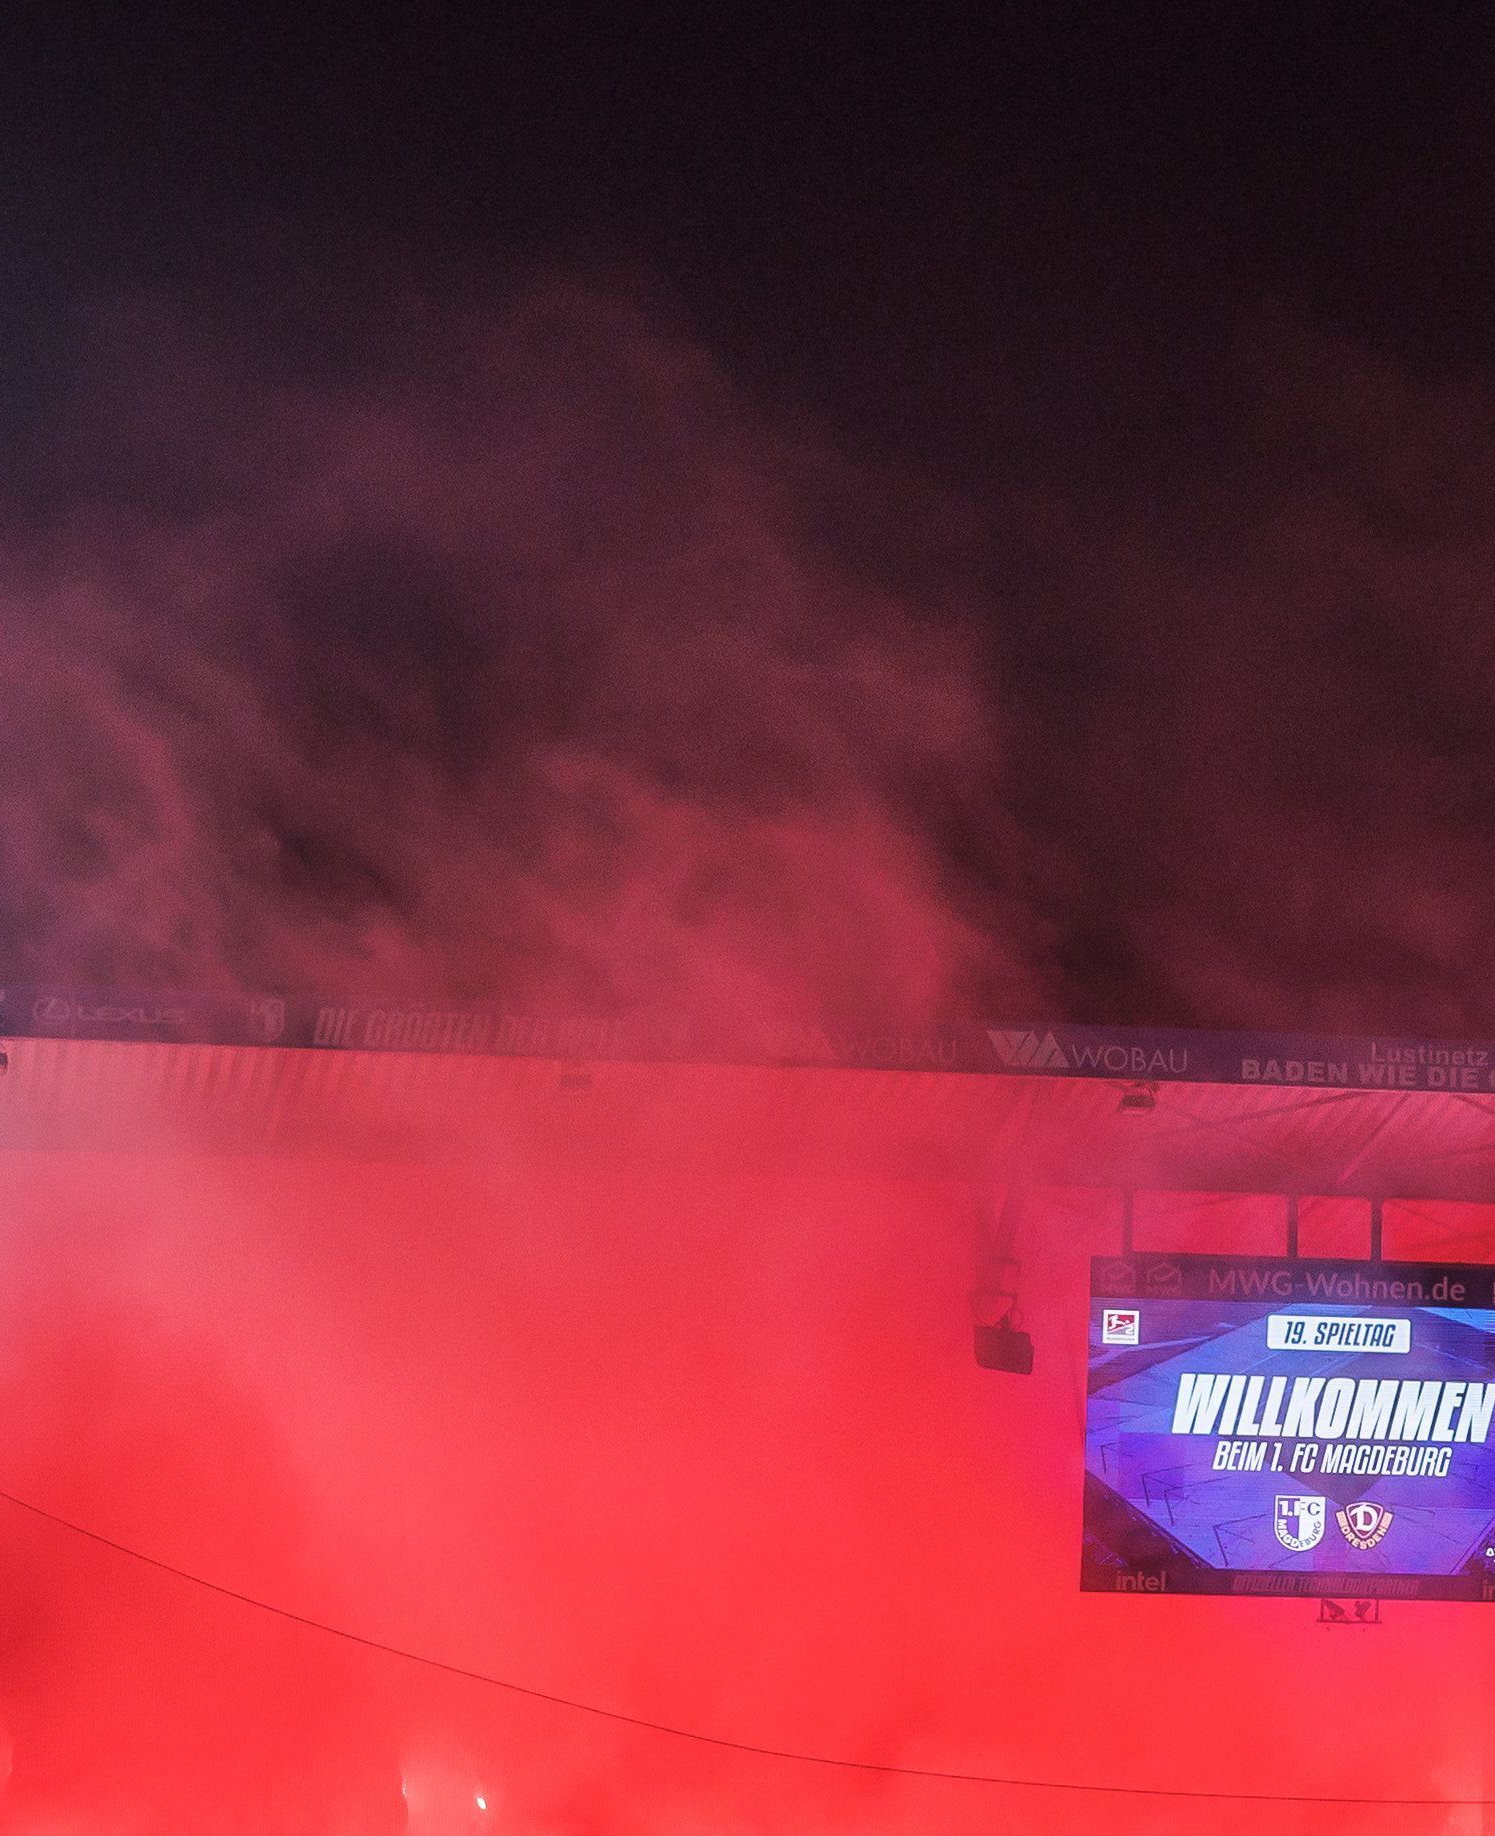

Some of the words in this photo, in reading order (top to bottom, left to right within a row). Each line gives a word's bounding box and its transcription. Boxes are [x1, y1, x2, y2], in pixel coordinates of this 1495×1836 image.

[76, 1004, 186, 1025] LEXUS
[1069, 1044, 1189, 1073] WOBAU
[1370, 1042, 1489, 1067] Lustinetz
[1240, 1058, 1348, 1084] BADEN
[1357, 1062, 1416, 1087] WIE
[1425, 1064, 1479, 1090] DIE
[1208, 1269, 1467, 1303] MWG-Wohnen.de
[1283, 1320, 1308, 1346] 19.
[1314, 1322, 1397, 1348] SPIELTAG
[1212, 1440, 1268, 1472] BEIM
[1271, 1441, 1285, 1472] 1.
[1290, 1443, 1319, 1474] FC
[1320, 1444, 1453, 1478] MAGDEBURG
[1115, 1570, 1167, 1592] intel
